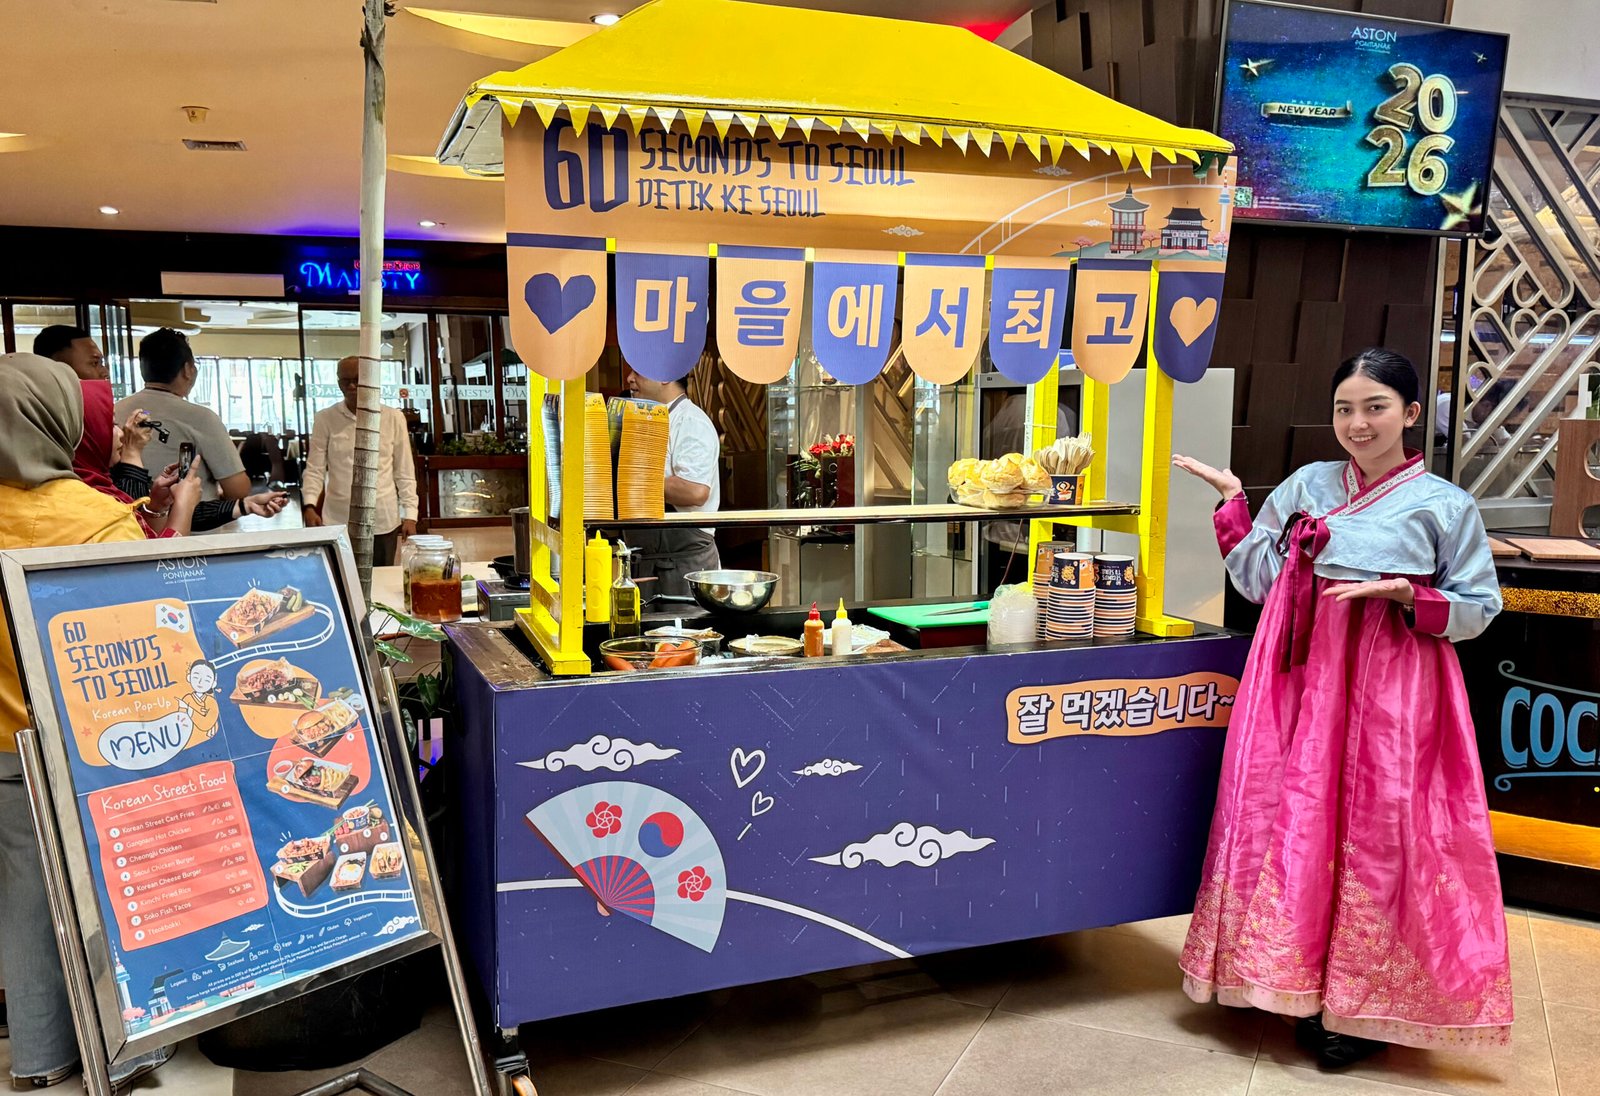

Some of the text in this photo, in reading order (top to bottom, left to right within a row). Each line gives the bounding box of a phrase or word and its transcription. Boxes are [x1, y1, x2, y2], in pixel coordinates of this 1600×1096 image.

[1351, 26, 1397, 42] ASTON
[1278, 105, 1337, 116] NEW YEAR
[639, 128, 916, 187] SECONDS TO SEOUL
[636, 178, 826, 218] DETIK KE SEOUL
[162, 569, 205, 580] PONTIANAK
[64, 634, 161, 674] SECONDS
[72, 662, 178, 702] TO SEOUL
[92, 696, 172, 721] Korean Pop-Up
[1016, 682, 1236, 736] 잘 먹겠습니다~
[1501, 686, 1600, 769] COC
[110, 723, 181, 760] MENU
[100, 794, 153, 814] Korean
[153, 781, 197, 801] Street
[122, 823, 143, 833] Korean
[144, 817, 164, 828] Street
[165, 814, 179, 822] Cart
[179, 810, 195, 819] Fries
[167, 826, 191, 837] Chicken
[158, 842, 182, 854] Chicken
[132, 867, 150, 877] Seoul
[151, 860, 175, 872] Chicken
[175, 855, 195, 866] Burger
[136, 880, 158, 892] Korean
[158, 873, 181, 885] Cheese
[181, 867, 202, 879] Burger
[161, 890, 178, 900] Fried
[159, 906, 173, 915] Fish
[173, 901, 192, 911] Tacos
